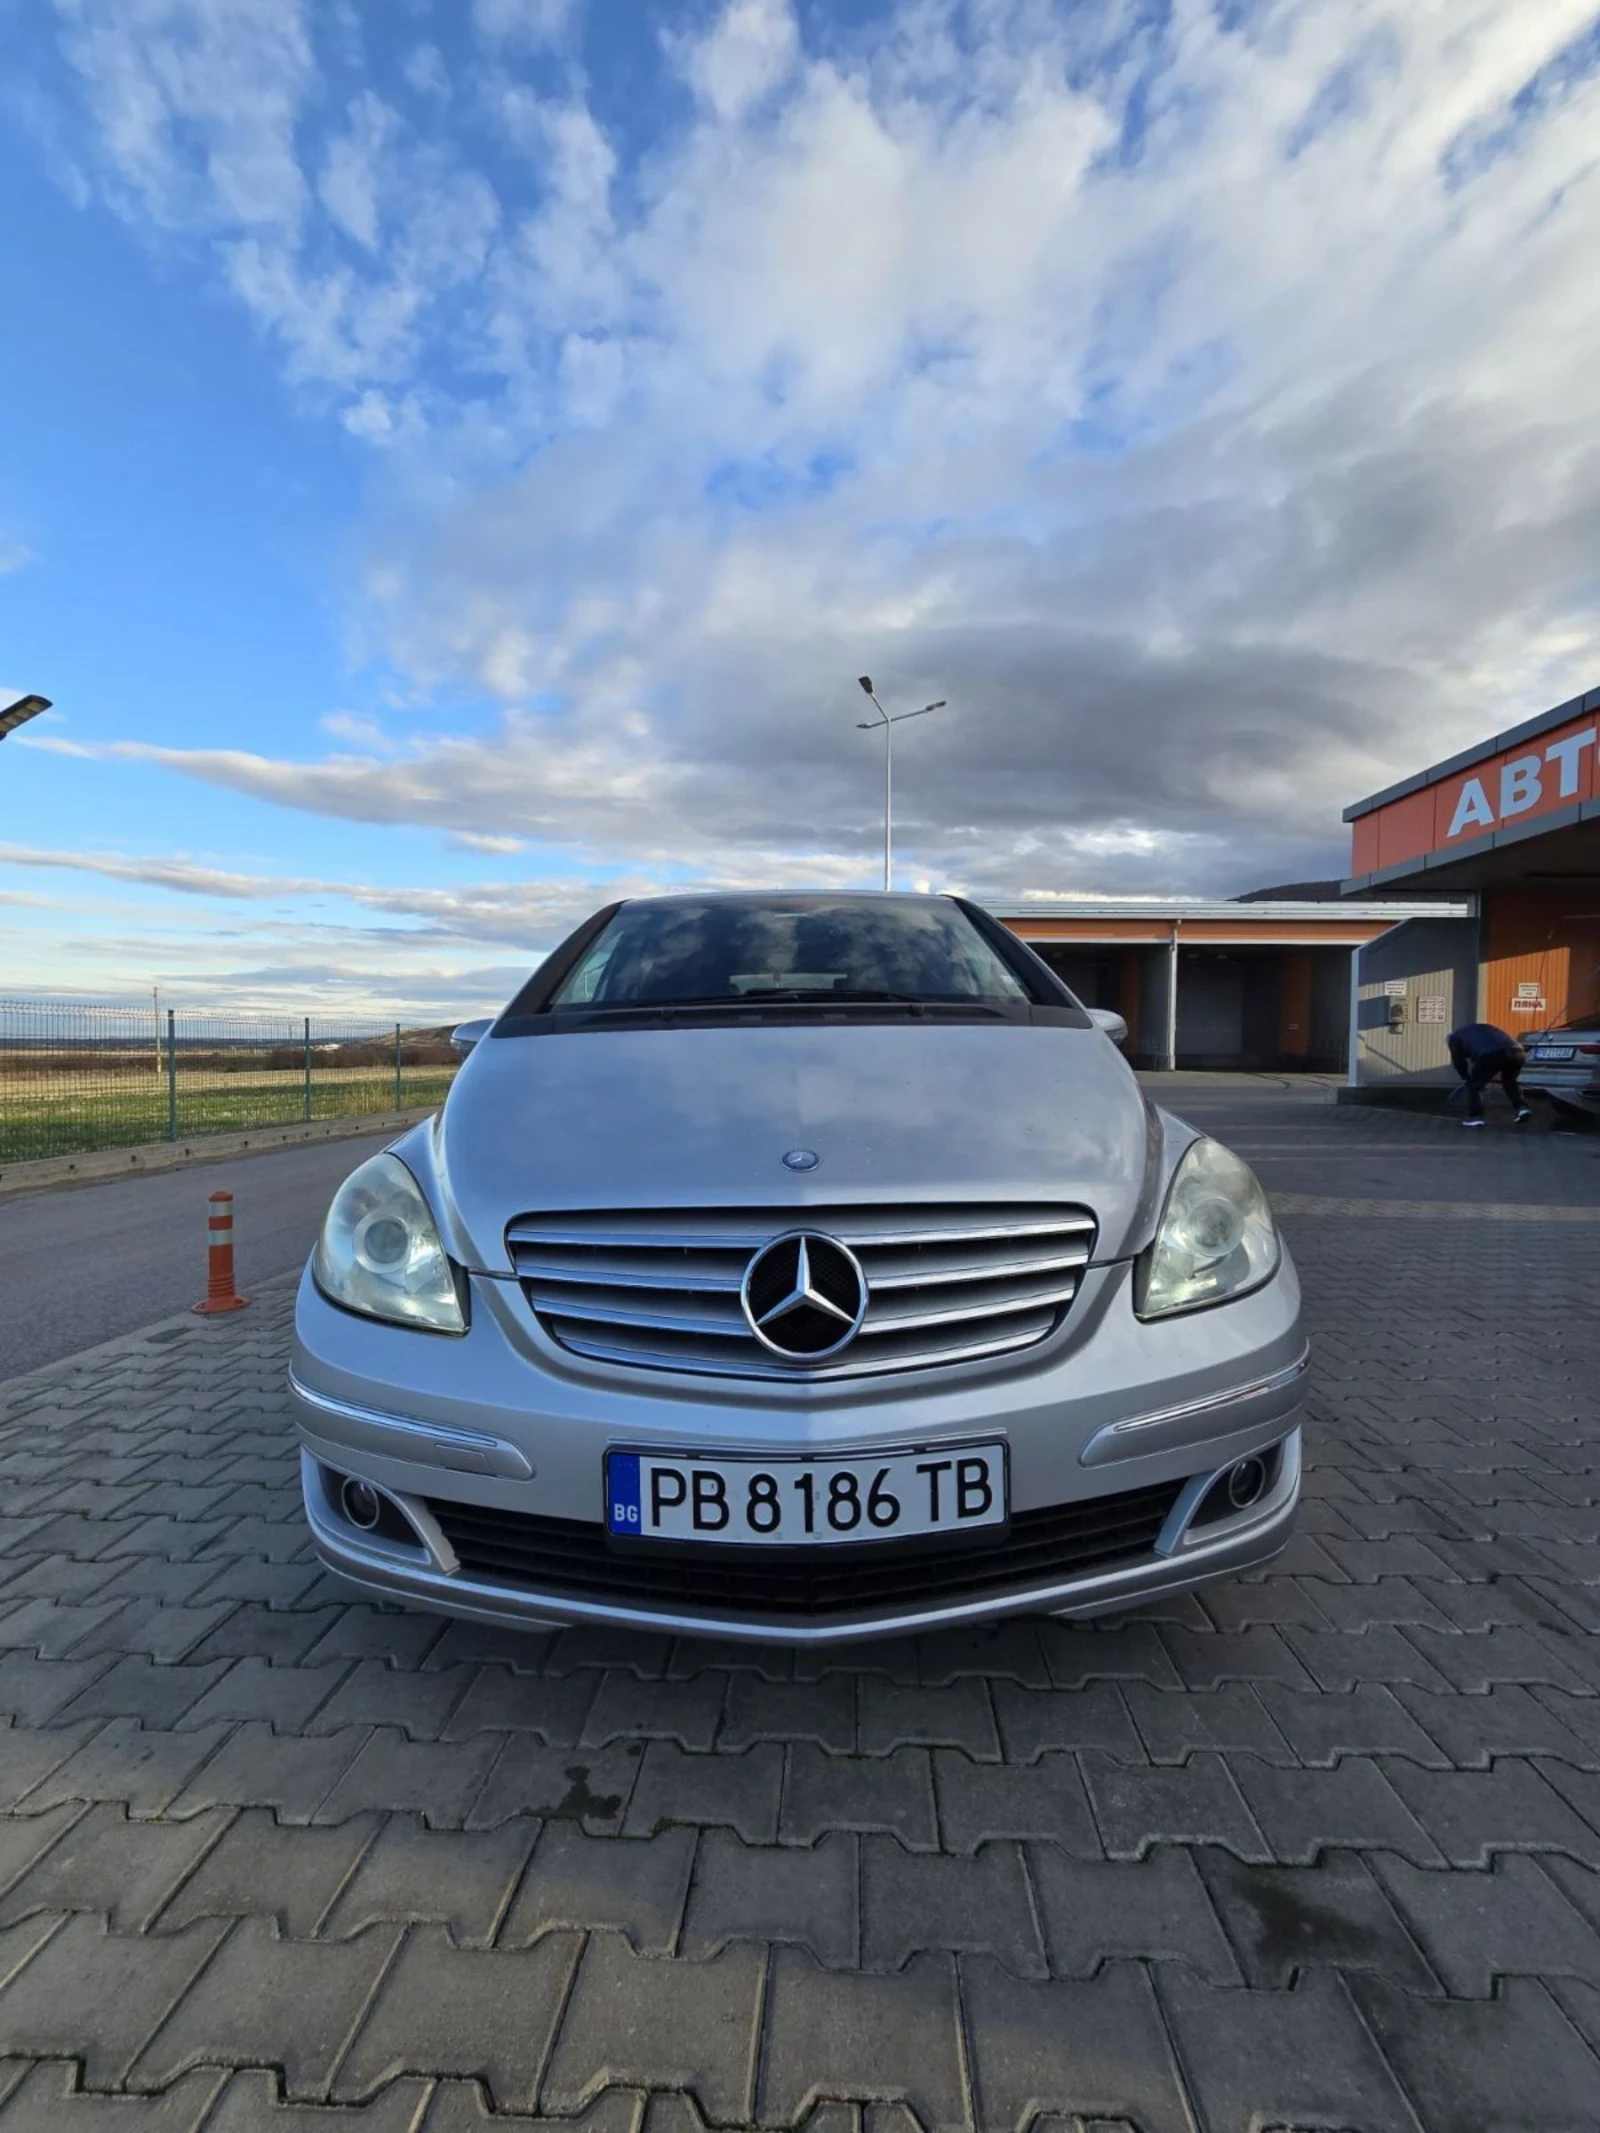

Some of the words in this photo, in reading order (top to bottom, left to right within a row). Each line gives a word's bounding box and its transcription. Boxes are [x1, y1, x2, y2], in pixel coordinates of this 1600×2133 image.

[1447, 727, 1600, 838] АВТ
[614, 1503, 638, 1522] BG
[651, 1467, 729, 1530] PB
[747, 1467, 900, 1533] 8186
[916, 1457, 992, 1523] TB
